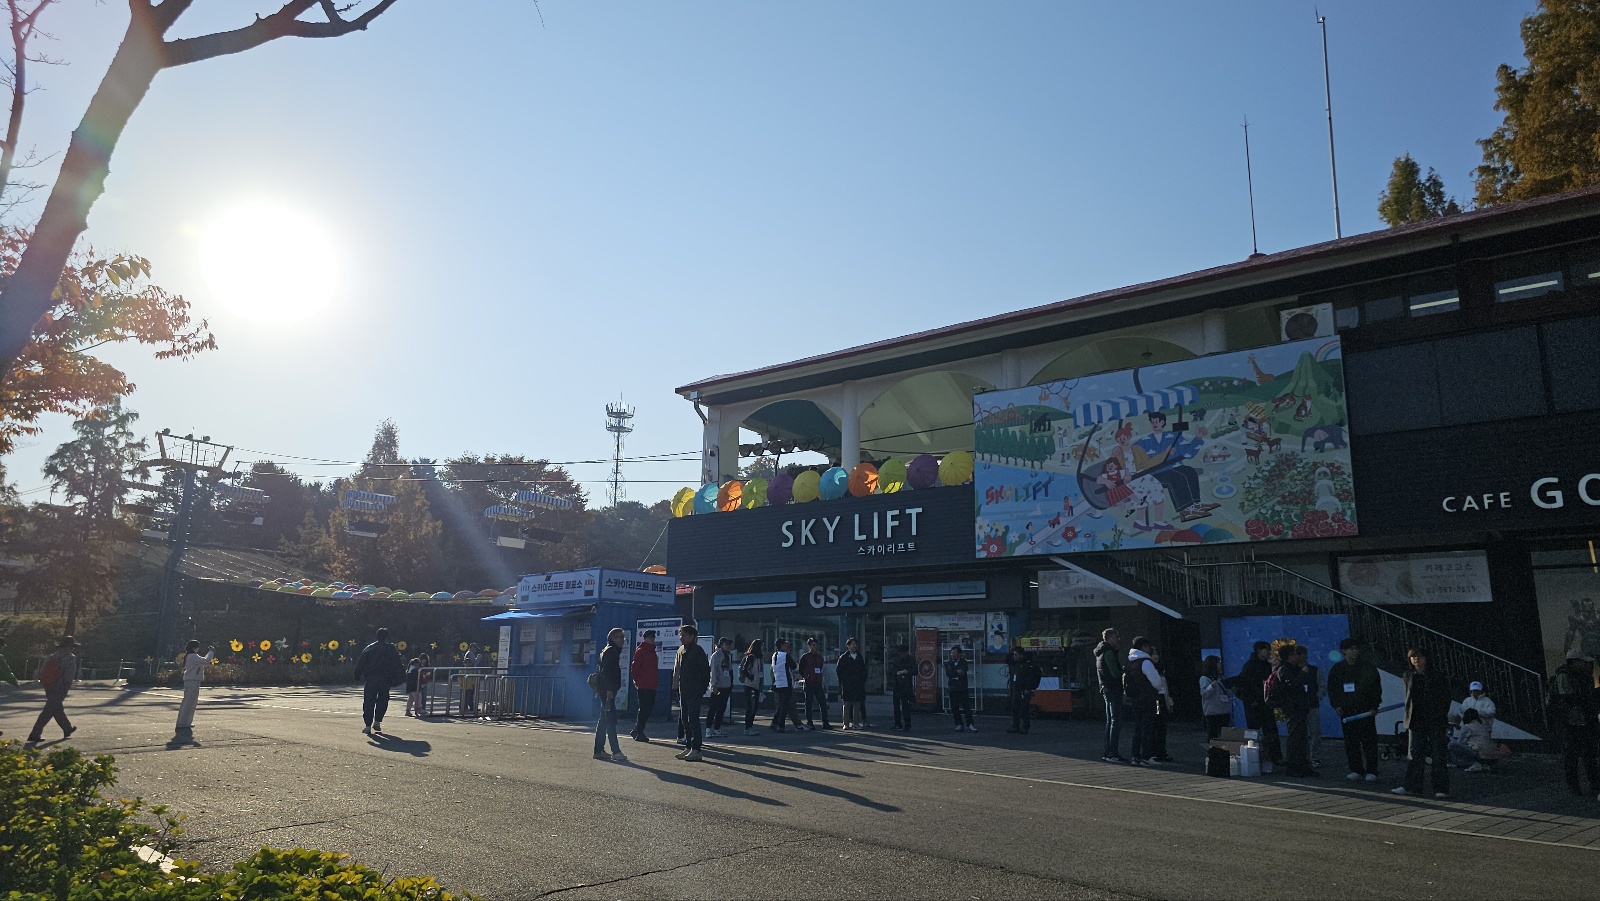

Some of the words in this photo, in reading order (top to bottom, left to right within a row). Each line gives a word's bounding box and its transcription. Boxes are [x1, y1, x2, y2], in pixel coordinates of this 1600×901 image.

[1442, 491, 1512, 513] CAFE
[781, 515, 841, 548] SKY
[854, 507, 923, 541] LIFT
[857, 542, 917, 556] 스카이리프트
[531, 582, 564, 593] 스카이리프트
[605, 578, 650, 591] 스카이리프트
[651, 582, 672, 593] 매표소
[809, 583, 868, 609] GS25
